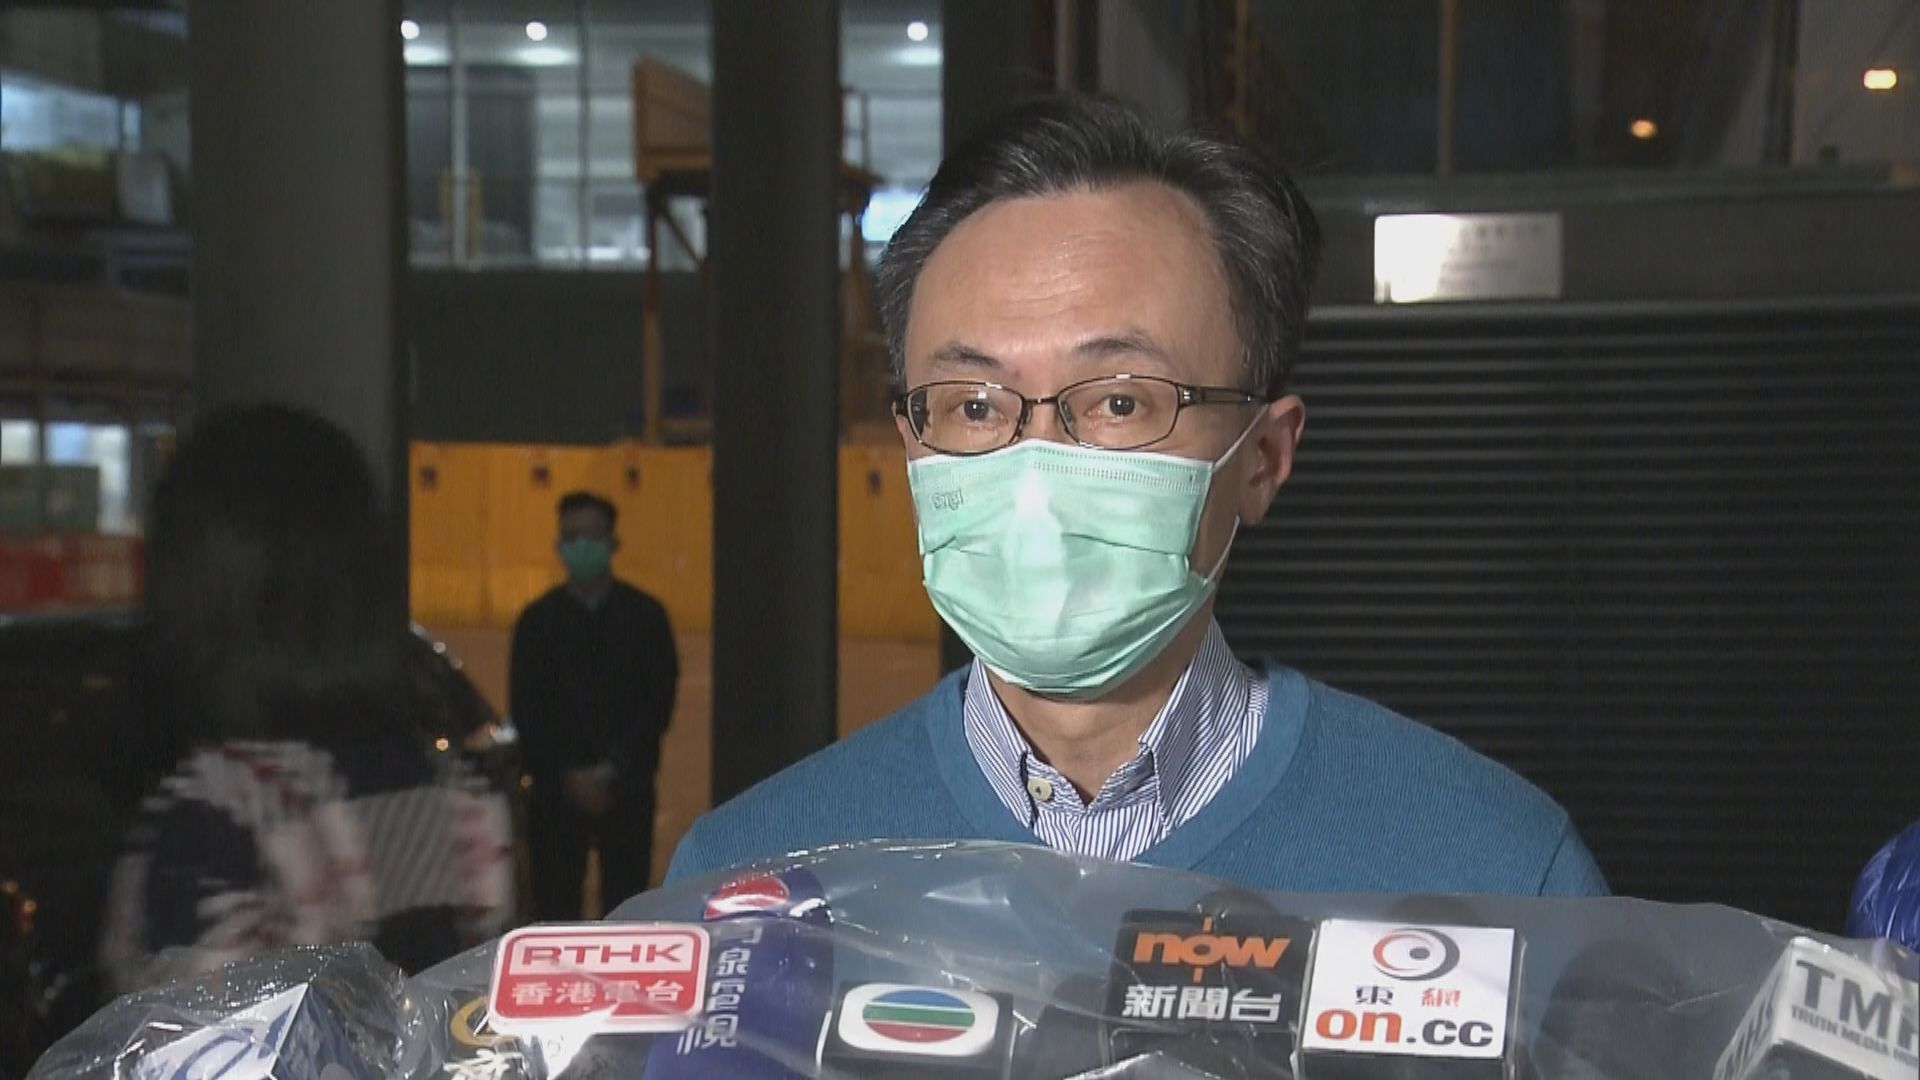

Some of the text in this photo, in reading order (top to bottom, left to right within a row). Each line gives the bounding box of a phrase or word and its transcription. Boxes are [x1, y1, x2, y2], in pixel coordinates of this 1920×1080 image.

[521, 943, 686, 966] RTHK
[1132, 930, 1291, 970] now
[511, 980, 685, 1006] 香港電台
[1121, 983, 1283, 1023] 新聞台
[1315, 1008, 1494, 1048] on.cc
[1790, 1004, 1890, 1057] TRUTH MEDIA
